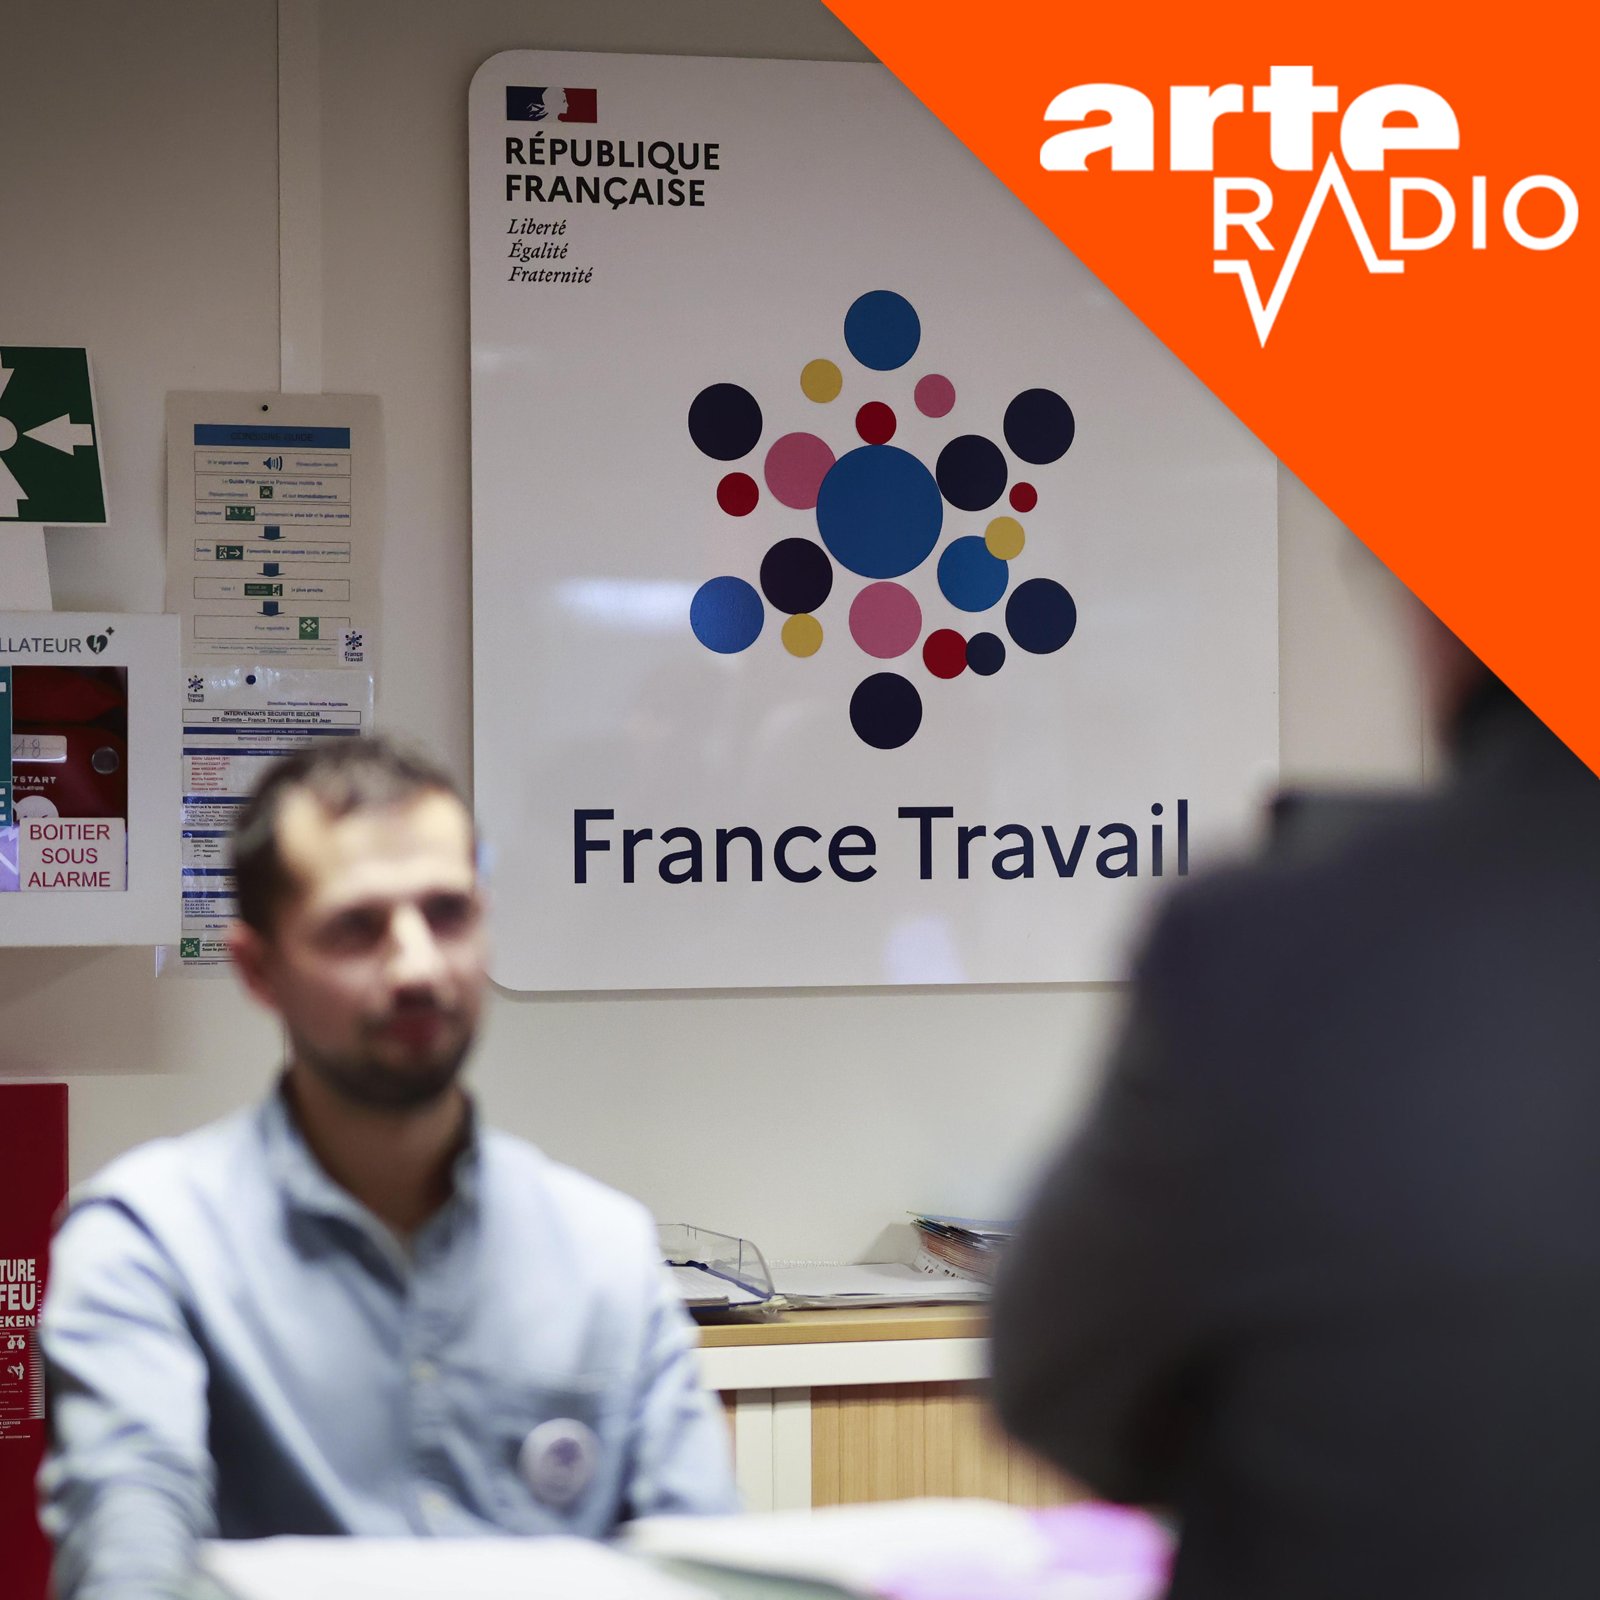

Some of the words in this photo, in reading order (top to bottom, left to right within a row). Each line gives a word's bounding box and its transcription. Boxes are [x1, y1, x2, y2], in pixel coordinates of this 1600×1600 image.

[505, 131, 720, 175] RÉPUBLIQUE
[505, 174, 705, 210] FRANÇAISE
[507, 218, 567, 236] Liberté
[508, 239, 568, 263] Égalité
[508, 266, 593, 284] Fraternité
[0, 637, 82, 653] LLATEUR
[29, 824, 111, 841] BOITIER
[573, 808, 877, 885] France
[898, 798, 1189, 880] Travail
[41, 847, 98, 865] SOUS
[28, 871, 111, 888] ALARME
[0, 1258, 36, 1283] TURE
[0, 1283, 36, 1311] FEU
